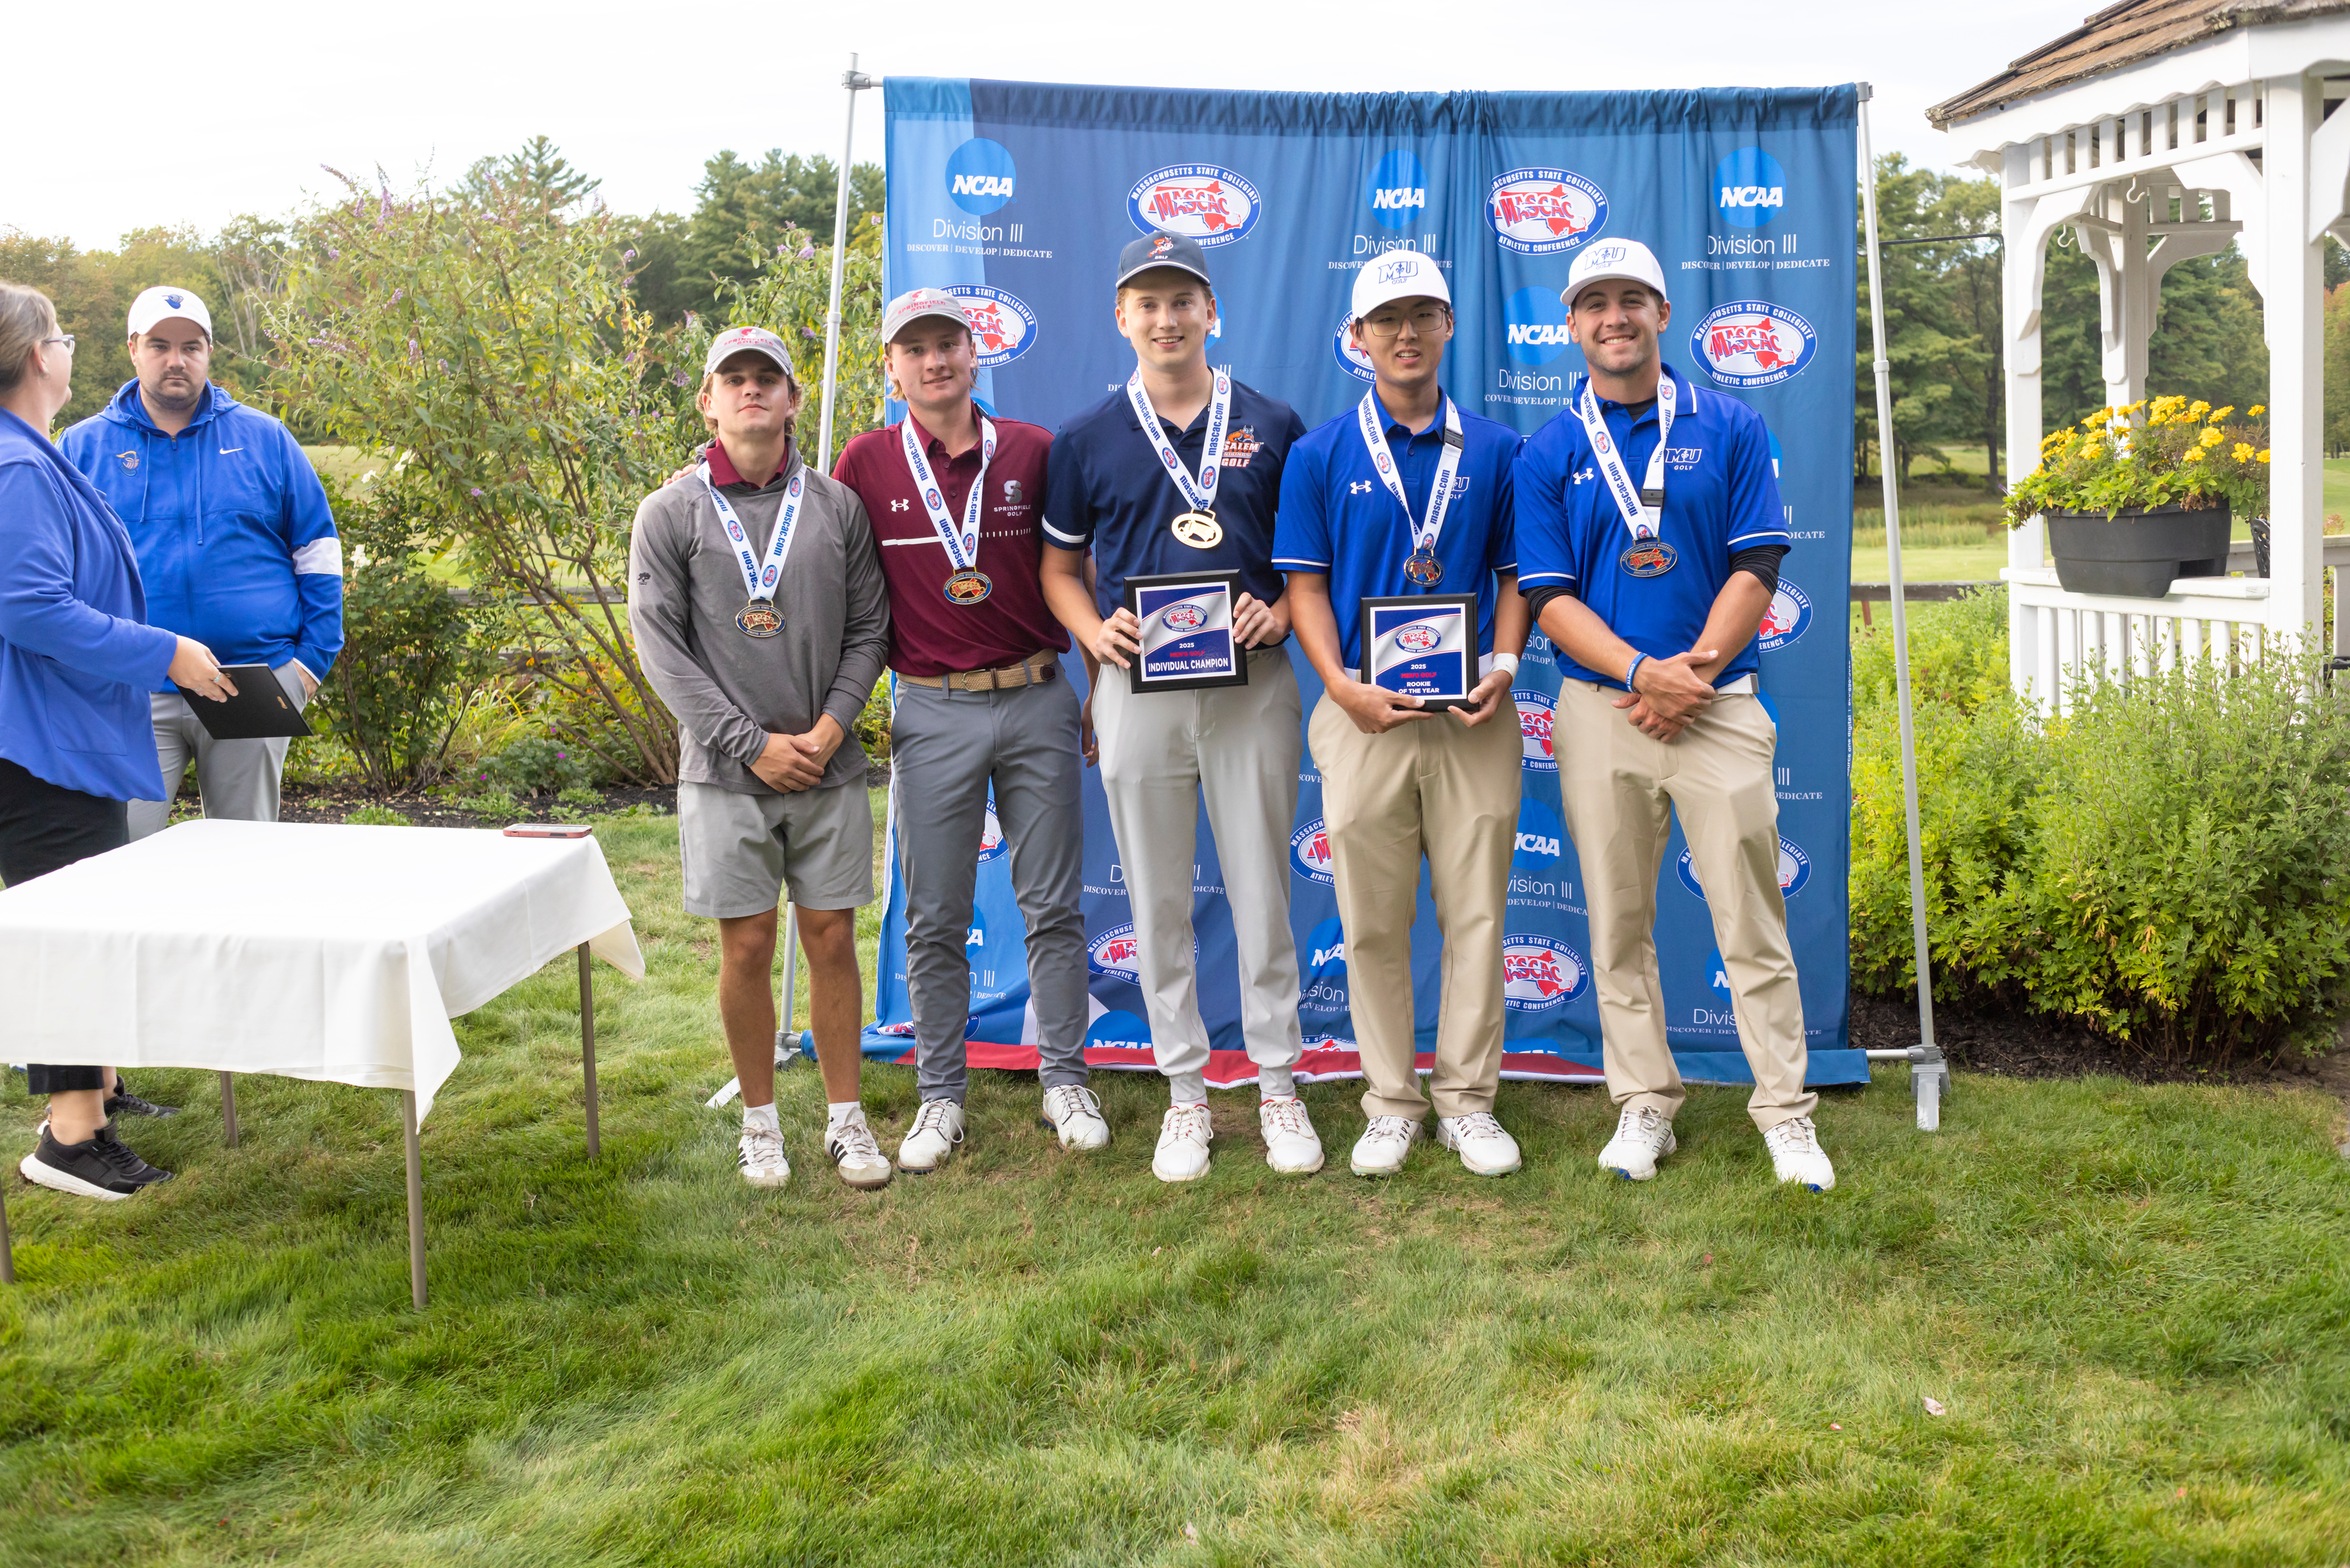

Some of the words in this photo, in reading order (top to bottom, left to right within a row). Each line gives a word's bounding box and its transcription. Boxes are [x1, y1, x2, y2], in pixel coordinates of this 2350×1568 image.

[952, 174, 1013, 198] NCAA
[1131, 167, 1193, 200] MASSACHUSETTS
[1196, 166, 1219, 177] STATE
[1222, 172, 1259, 205] COLLEGIATE
[1538, 170, 1562, 181] STATE
[1565, 175, 1606, 208] COLLEGIATE
[1153, 189, 1230, 223] MASCAC
[1373, 187, 1425, 209] NCAA
[1720, 186, 1784, 208] NCAA
[1498, 193, 1575, 228] MASCAC
[933, 218, 1003, 242] Division
[1009, 223, 1023, 243] III
[1194, 232, 1235, 247] NFERENCE
[906, 243, 949, 252] DISCOVER
[955, 244, 997, 256] DEVELOP
[1003, 248, 1053, 259] DEDICATE
[1353, 235, 1417, 254] Division
[1423, 234, 1436, 253] III
[1498, 235, 1530, 252] ATHLETIC
[1533, 236, 1581, 253] CONFERENCE
[1707, 233, 1775, 255] Division
[1782, 233, 1797, 254] III
[1681, 260, 1721, 270] DISCOER
[1726, 260, 1770, 270] DEVELOP
[1776, 258, 1830, 270] DEDICATE
[975, 288, 996, 298] STATE
[998, 293, 1035, 327] COLLEGIATE
[1746, 303, 1769, 314] STATE
[1772, 308, 1814, 341] COLLEGIATE
[1508, 323, 1570, 345] NCAA
[1711, 327, 1782, 363] MASCAC
[978, 352, 1011, 365] NFERENCE
[1499, 368, 1562, 391] Division
[1742, 369, 1789, 386] CONFERENCE
[1513, 396, 1557, 406] DEVELOP
[1134, 390, 1161, 441] mascac.com
[1362, 397, 1380, 445] mascac.com
[1208, 402, 1224, 456] mascac.com
[905, 431, 929, 482] mascac.com
[1223, 440, 1261, 452] SALEM
[1221, 457, 1250, 468] GOLF
[1430, 469, 1450, 525] mascac.com
[1607, 461, 1638, 517] mascac.com
[773, 504, 795, 556] mascac.com
[1776, 580, 1809, 610] LLEGIATE
[1759, 637, 1785, 650] ERENCE
[1148, 660, 1189, 673] INDIVIDUAL
[1190, 657, 1229, 669] CHAMPION
[1521, 653, 1550, 665] EVELOP
[1533, 693, 1550, 706] STATE
[1777, 767, 1790, 786] III
[1083, 884, 1127, 896] DISCOVER
[1193, 885, 1225, 895] DICATE
[1561, 880, 1572, 900] III
[1507, 898, 1551, 908] DEVELOP
[1556, 902, 1588, 916] DEDICA
[1087, 925, 1133, 953] MASSACHUSE
[1528, 936, 1551, 947] STATE
[1554, 942, 1586, 976] COLLEGIATE
[1103, 968, 1132, 980] ATHLETIC
[1523, 995, 1565, 1010] CONFERENCE
